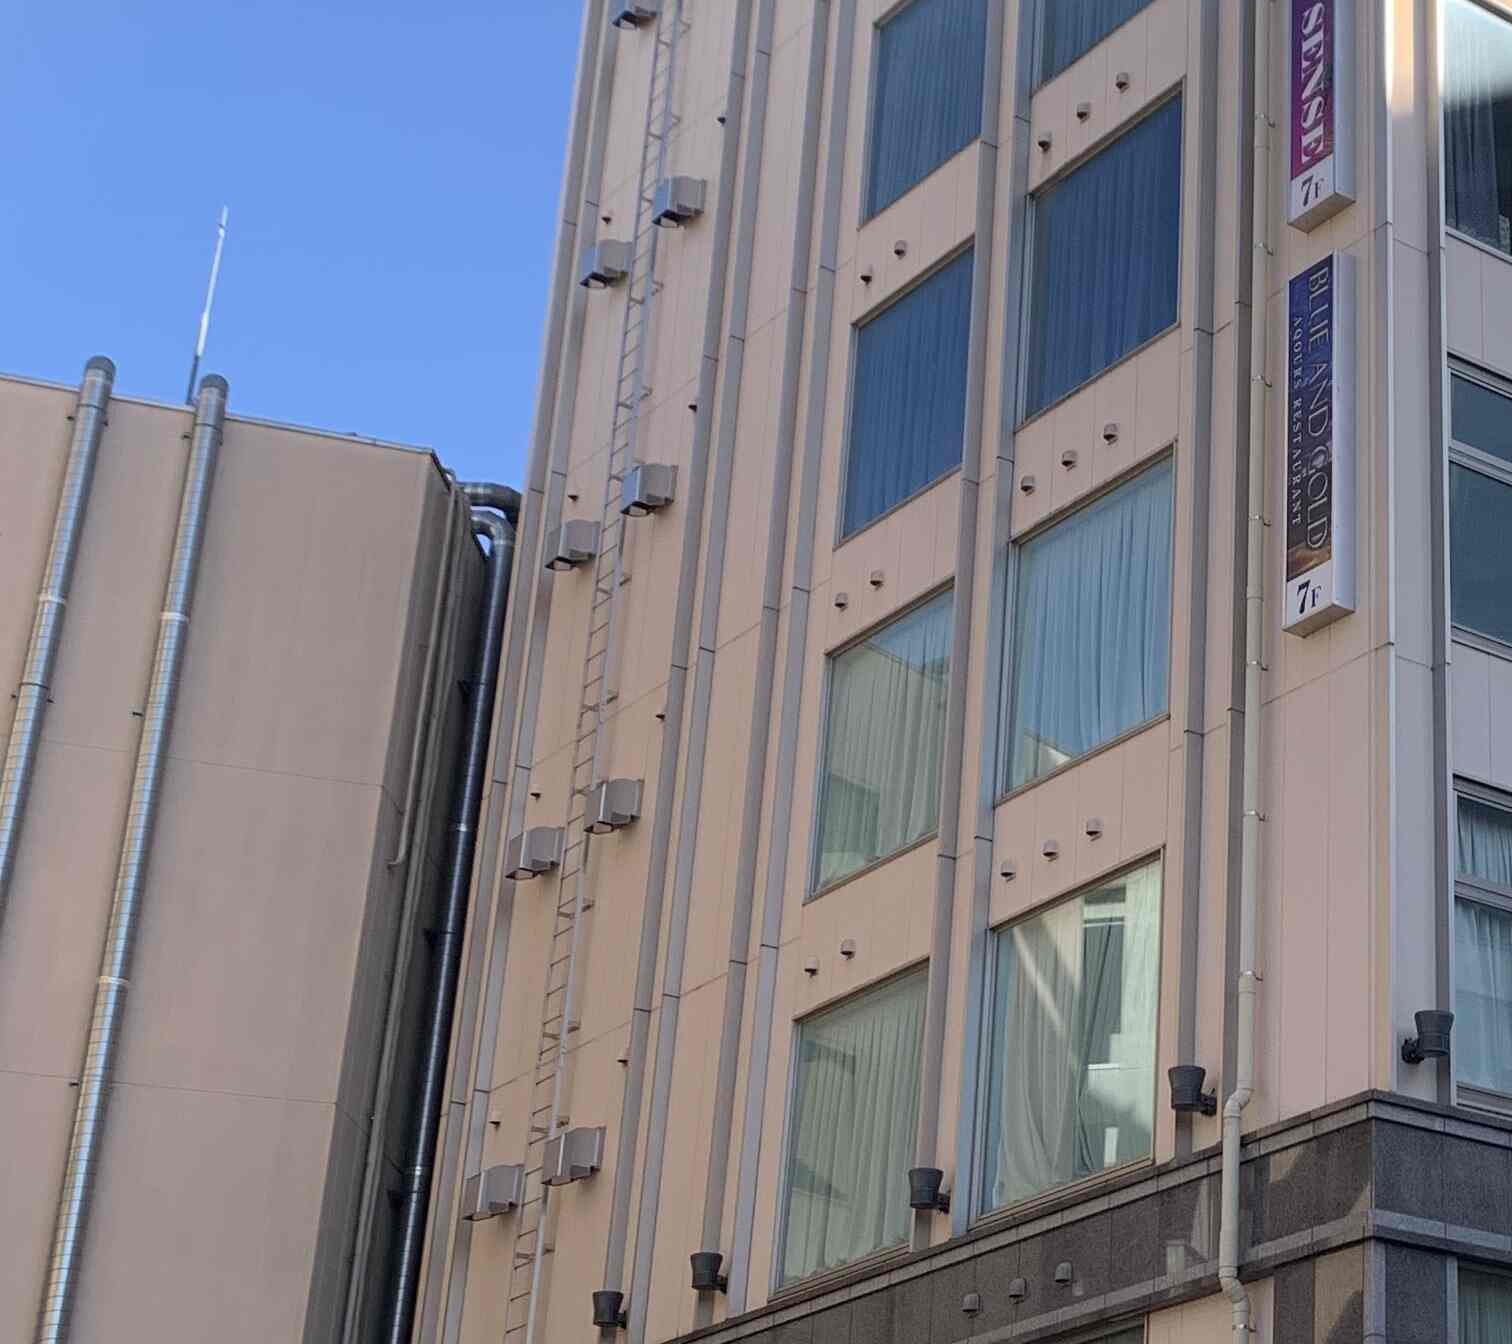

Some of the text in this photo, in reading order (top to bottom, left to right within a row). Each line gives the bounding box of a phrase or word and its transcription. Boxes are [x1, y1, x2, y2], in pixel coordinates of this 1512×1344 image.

[1300, 2, 1326, 163] SENSE
[1306, 265, 1330, 550] BLUE AND GOLD
[1296, 579, 1323, 615] 7F
